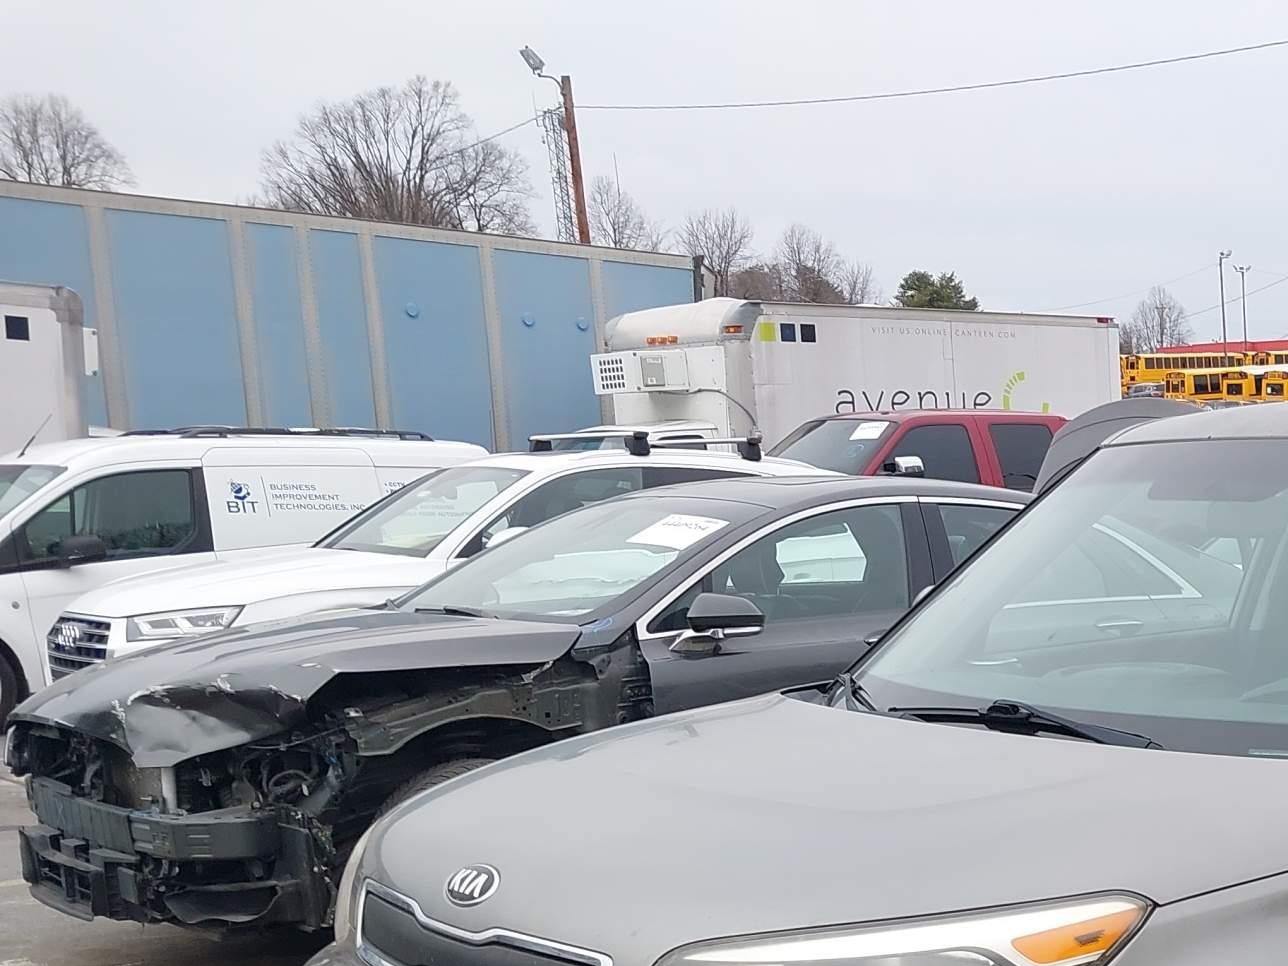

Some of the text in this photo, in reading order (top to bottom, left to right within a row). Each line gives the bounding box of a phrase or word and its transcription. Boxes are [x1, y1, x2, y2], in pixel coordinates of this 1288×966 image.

[871, 327, 894, 335] VISIT
[898, 327, 911, 336] US
[914, 327, 948, 337] ONLINE
[835, 389, 992, 413] avenue
[269, 483, 317, 491] BUSINESS
[271, 493, 340, 501] IMPROVEMENT
[226, 501, 259, 514] BIT
[448, 868, 489, 898] KIA
